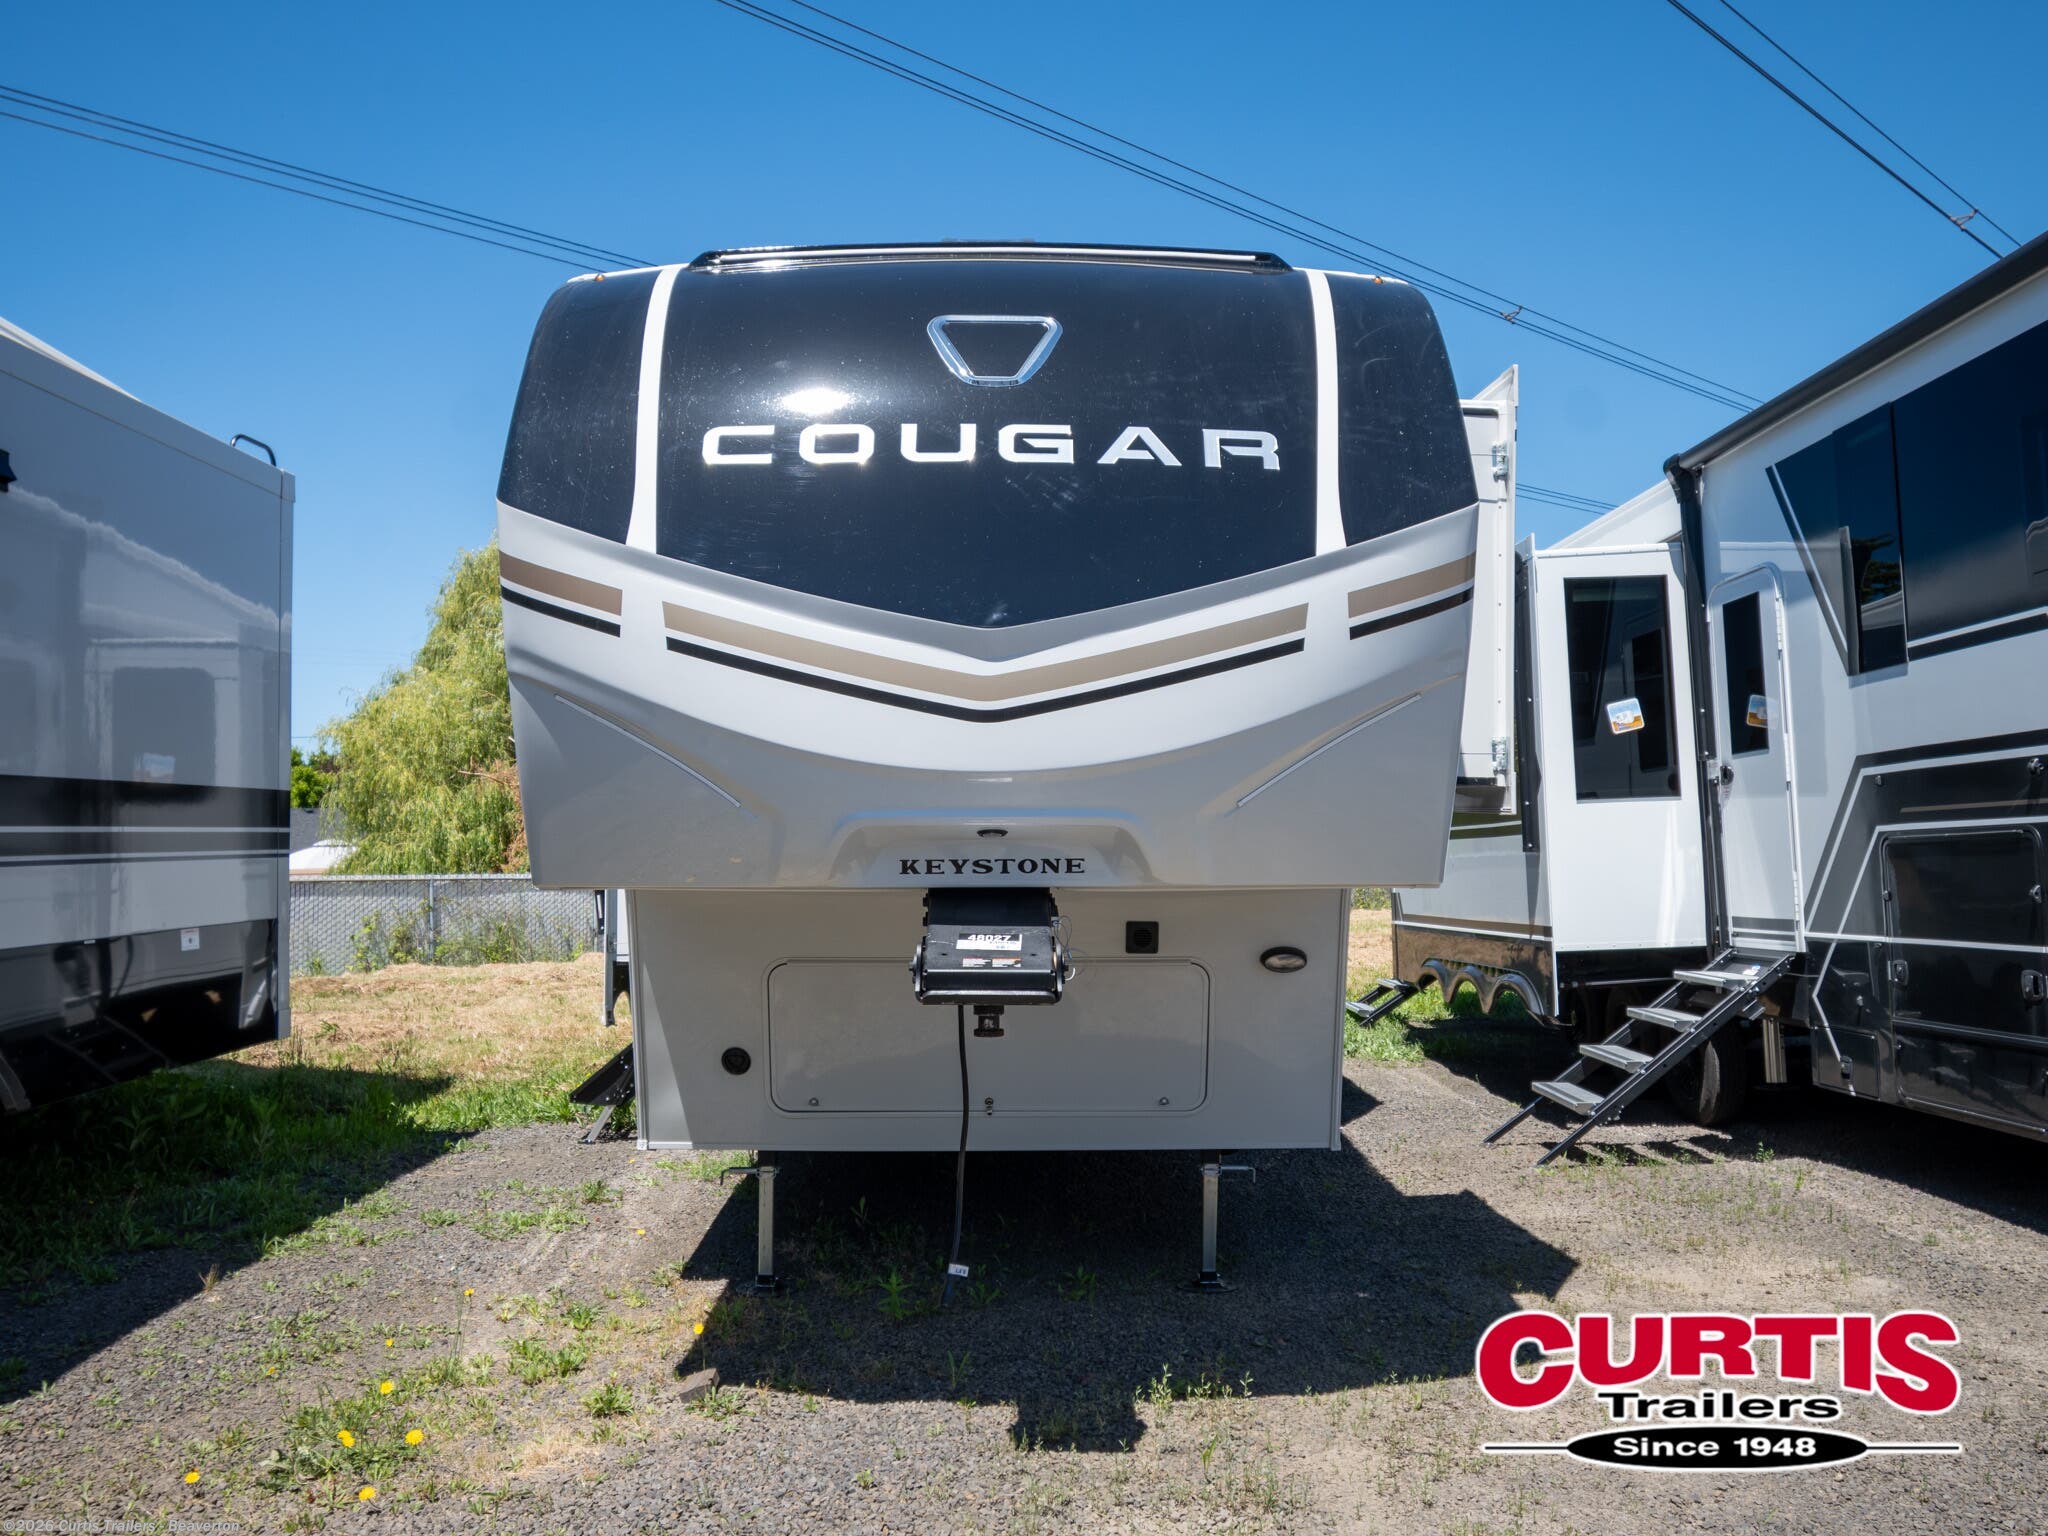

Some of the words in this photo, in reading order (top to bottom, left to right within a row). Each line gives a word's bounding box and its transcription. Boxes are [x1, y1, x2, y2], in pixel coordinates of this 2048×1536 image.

[701, 423, 1281, 471] COUGAR
[899, 857, 1085, 875] KEYSTONE
[967, 934, 1012, 942] 48027
